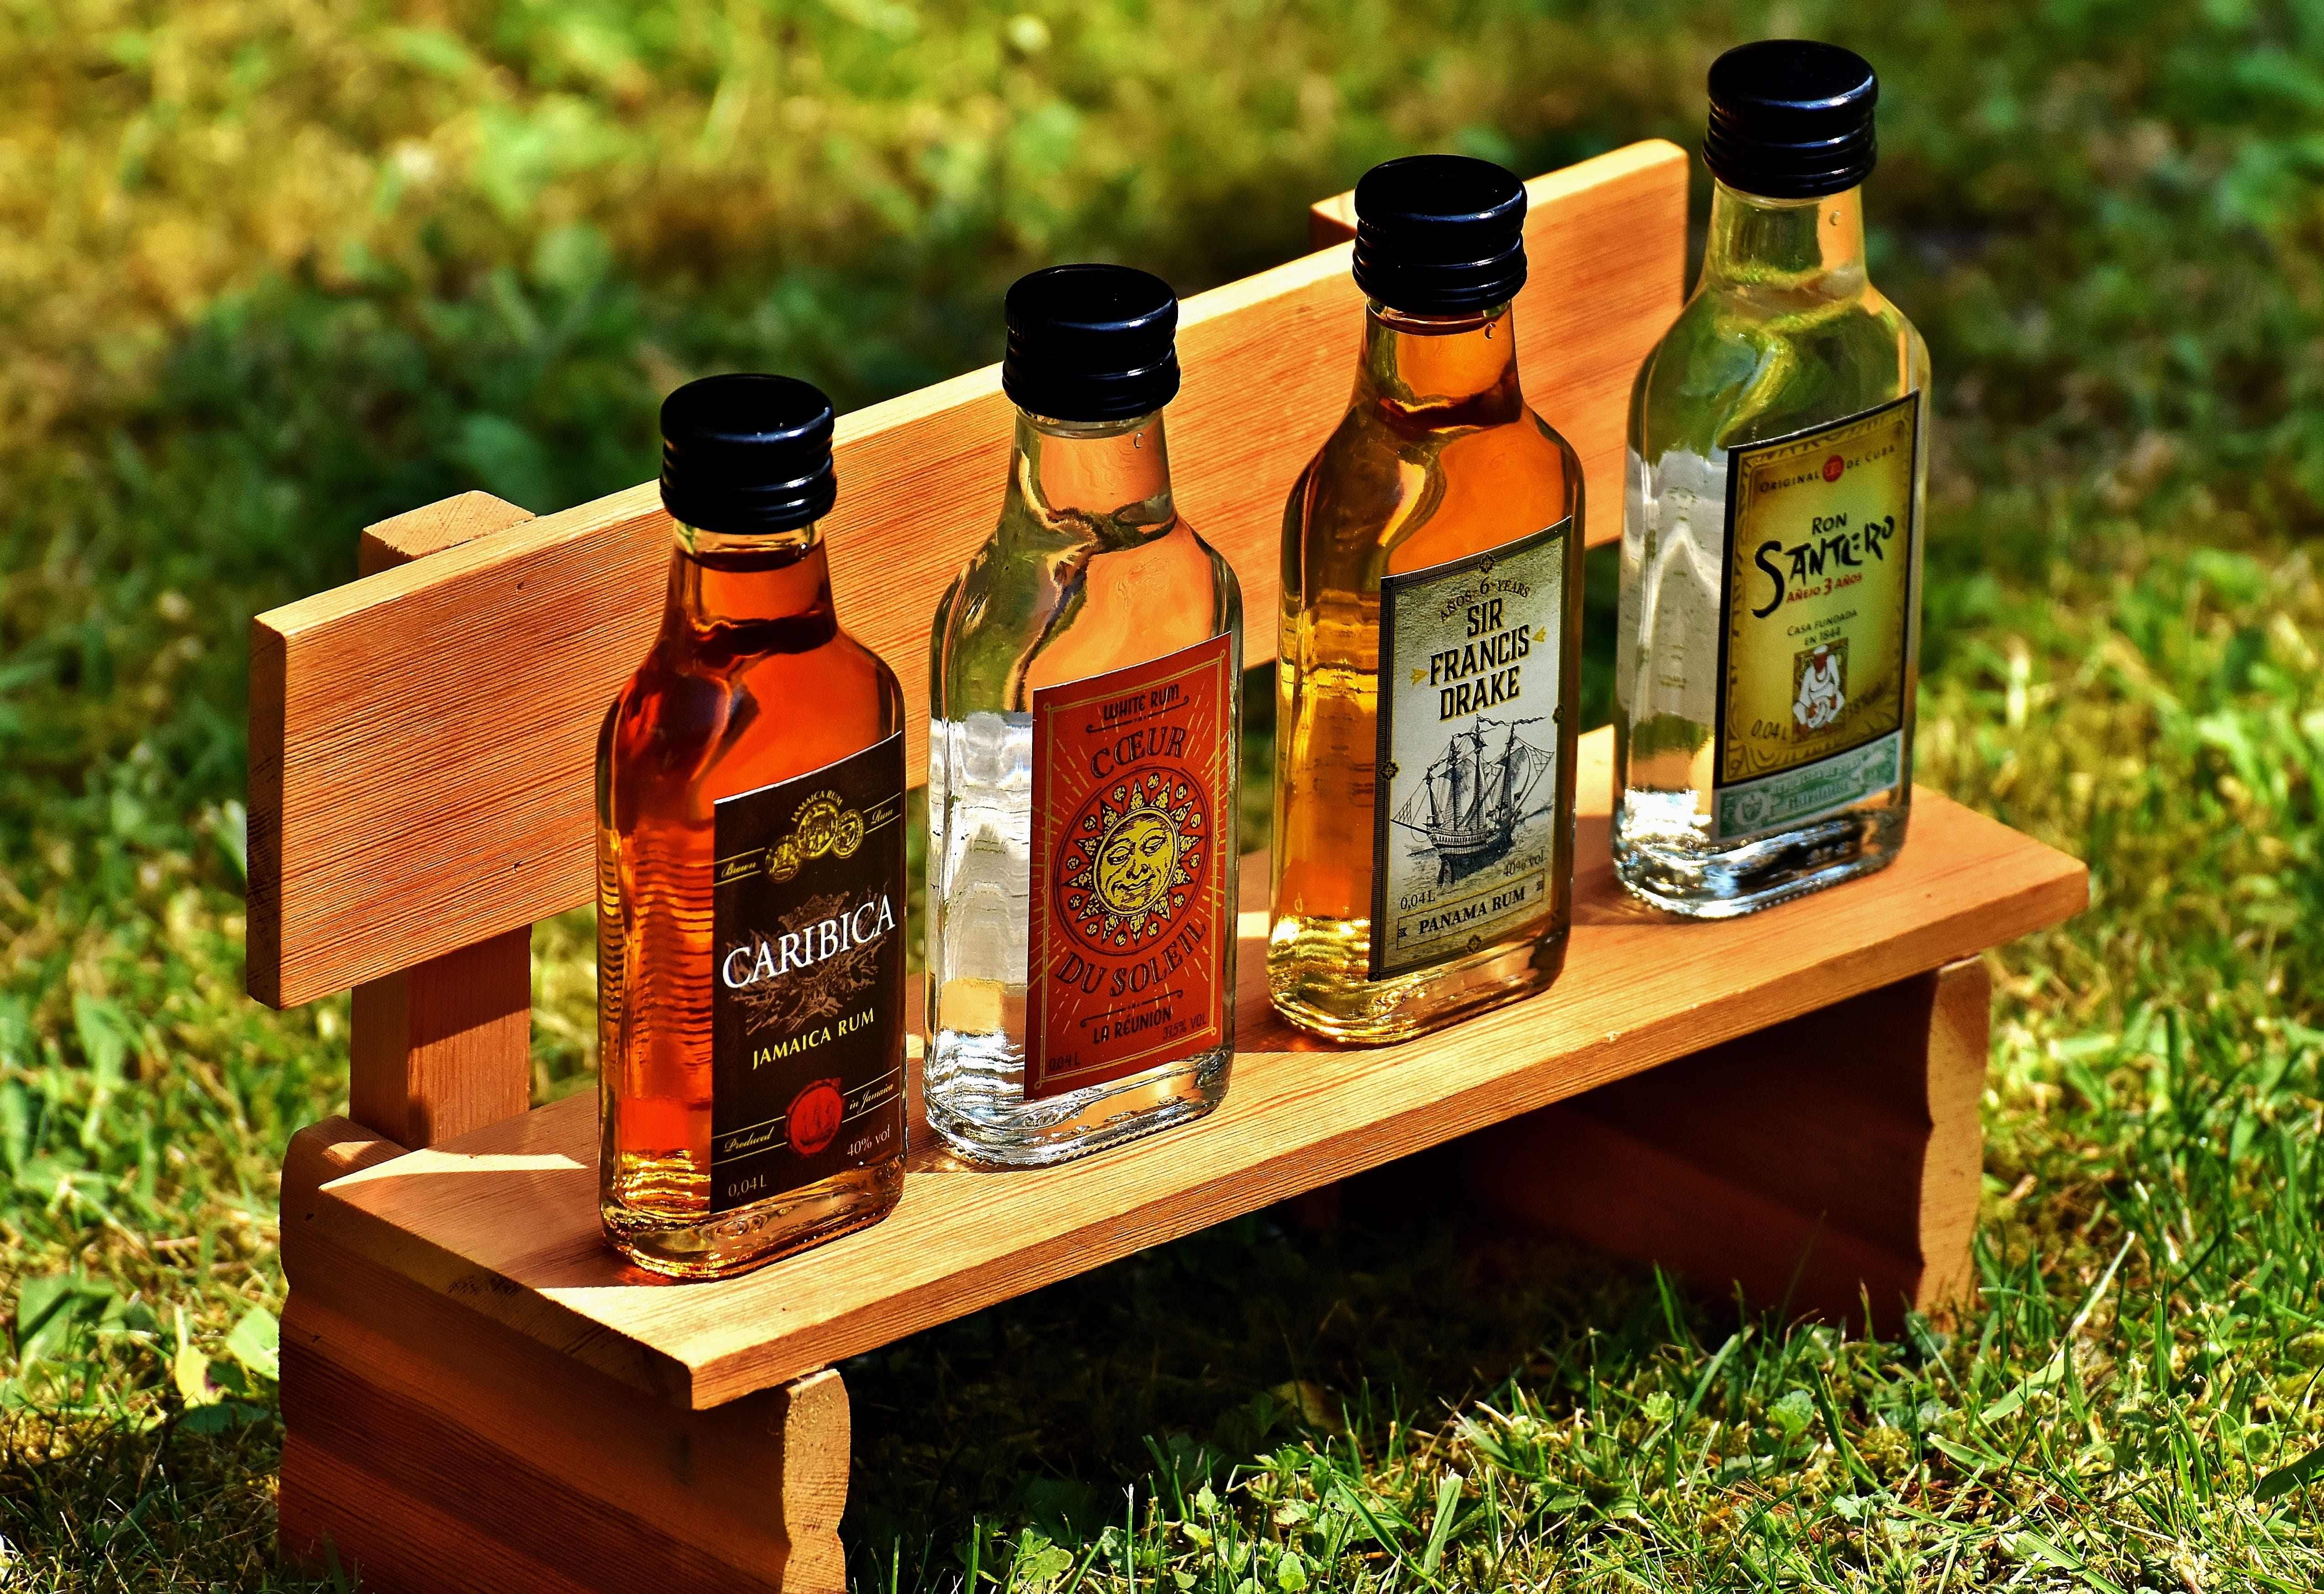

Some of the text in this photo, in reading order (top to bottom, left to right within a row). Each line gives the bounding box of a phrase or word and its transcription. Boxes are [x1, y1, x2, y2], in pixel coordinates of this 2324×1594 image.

[1760, 471, 1819, 492] ORIGINAL
[1812, 512, 1847, 535] RON
[1751, 515, 1894, 618] SANTERO
[1441, 576, 1530, 622] AÑOS 6 YEARS
[1786, 572, 1862, 603] AÑEJO 3 AÑOS
[1467, 597, 1503, 639] SIR
[1787, 623, 1812, 636] CASA
[1429, 624, 1530, 686] FRANCIS
[1103, 684, 1179, 721] WHITE RUM
[1439, 665, 1520, 721] DRAKE
[791, 790, 843, 822] JAMAICA RUM
[871, 808, 893, 825] Rum
[721, 861, 757, 878] Brown
[1419, 886, 1525, 935] PANAMA RUM
[722, 894, 896, 988] CARIBICA
[1055, 921, 1207, 997] DU SOLEIL
[1093, 1005, 1172, 1044] LA RÉUNION
[1190, 1012, 1207, 1029] VOL
[752, 1007, 874, 1070] JAMAICA RUM
[850, 1081, 893, 1114] in Jamaica
[723, 1126, 774, 1153] Produced
[847, 1124, 891, 1157] 40% vol
[761, 1174, 767, 1188] L
